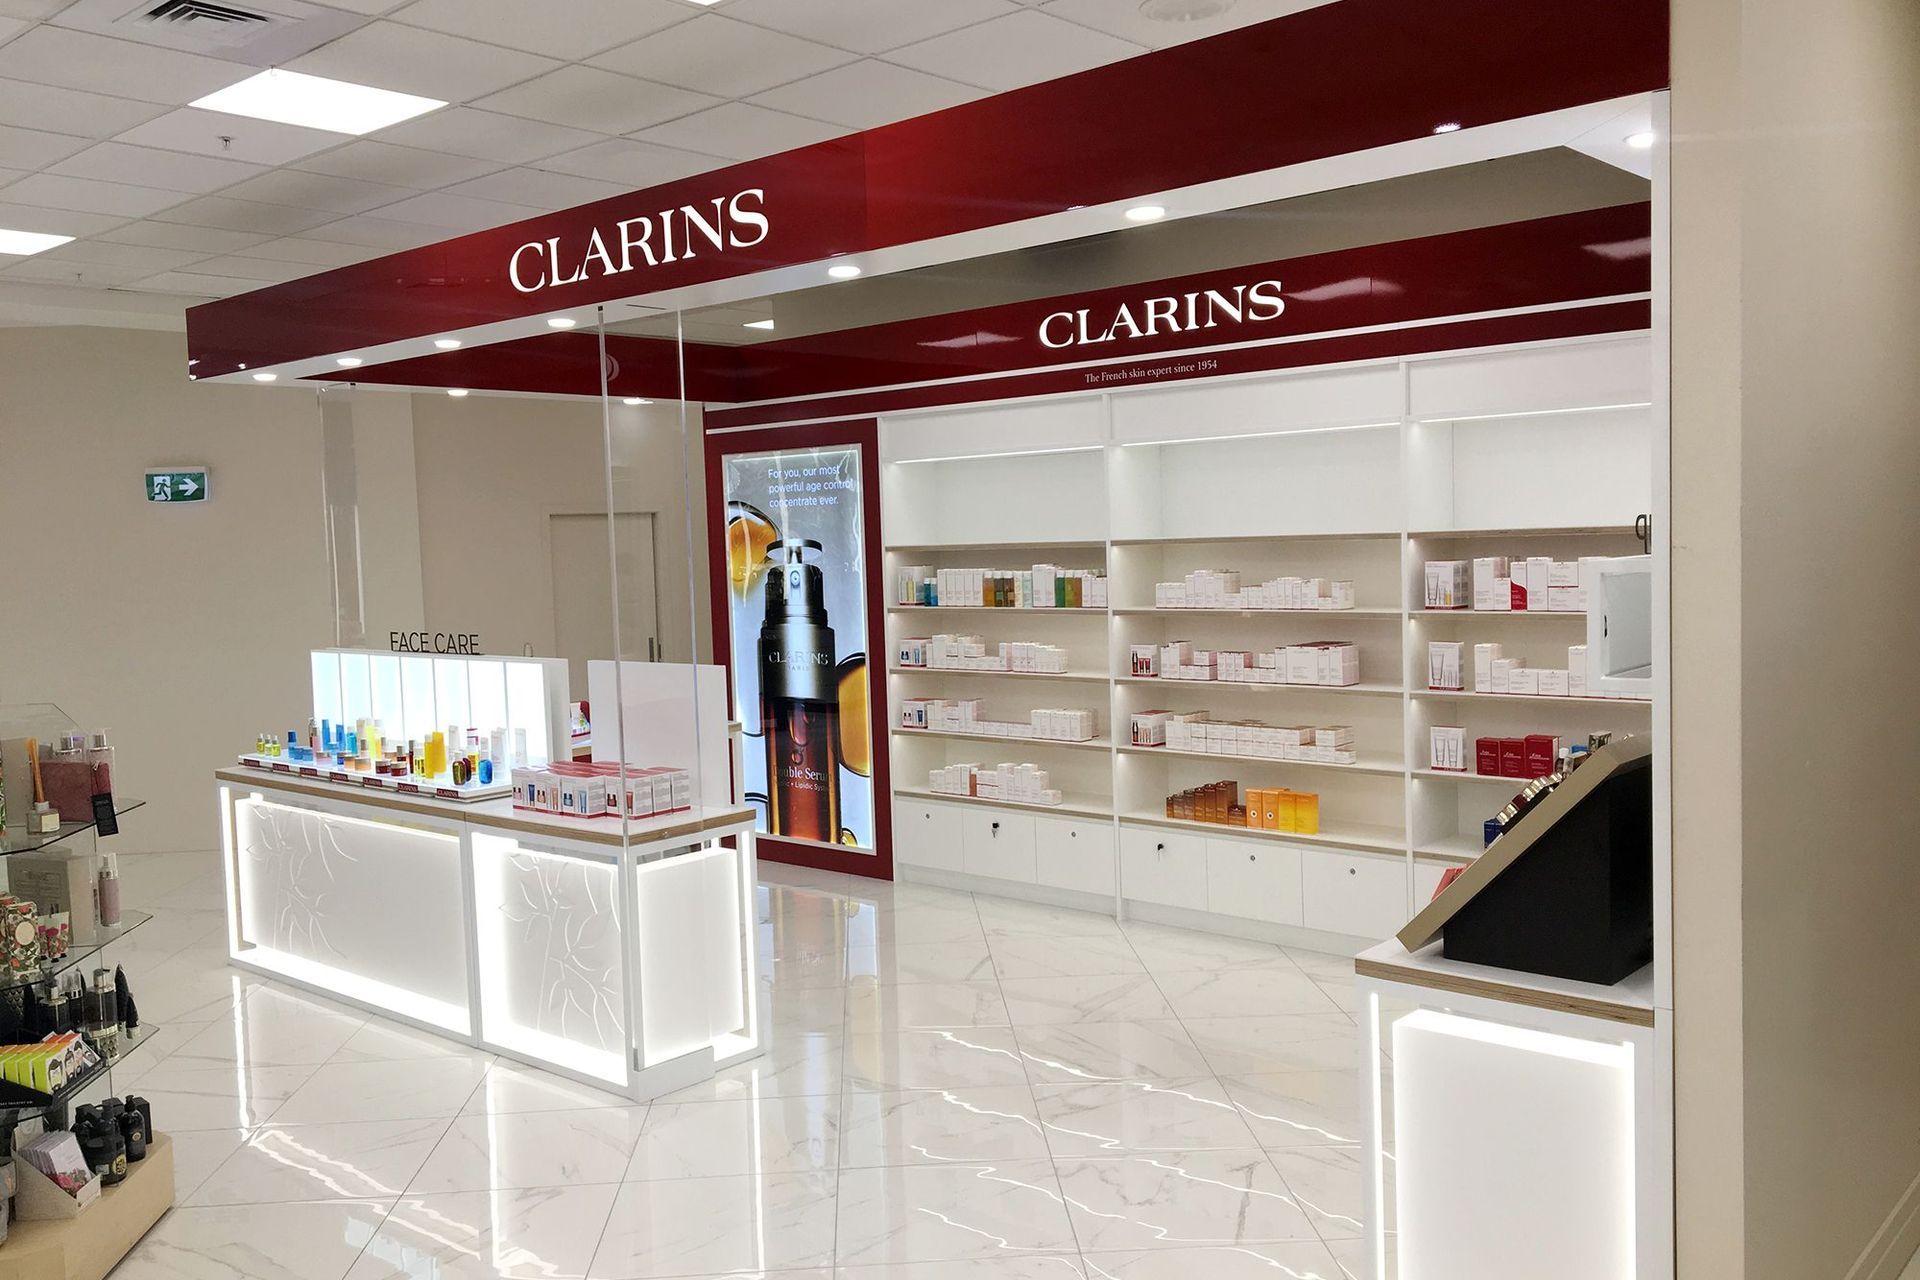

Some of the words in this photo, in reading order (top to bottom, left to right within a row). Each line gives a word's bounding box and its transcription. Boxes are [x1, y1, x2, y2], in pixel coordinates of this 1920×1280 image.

[509, 188, 769, 293] CLARINS
[1038, 280, 1286, 348] CLARINS
[1085, 373, 1100, 383] The
[1101, 369, 1128, 381] French
[1129, 367, 1146, 379] skin
[1147, 365, 1172, 378] expert
[1173, 363, 1195, 373] since
[1197, 360, 1218, 370] 1954
[768, 468, 782, 479] For
[803, 467, 817, 477] our
[819, 465, 840, 475] most
[768, 481, 804, 495] powerful
[806, 482, 822, 493] age
[823, 479, 853, 490] control
[769, 496, 817, 508] concentrate
[819, 496, 839, 505] ever.
[390, 631, 430, 653] FACE
[434, 632, 480, 655] CARE
